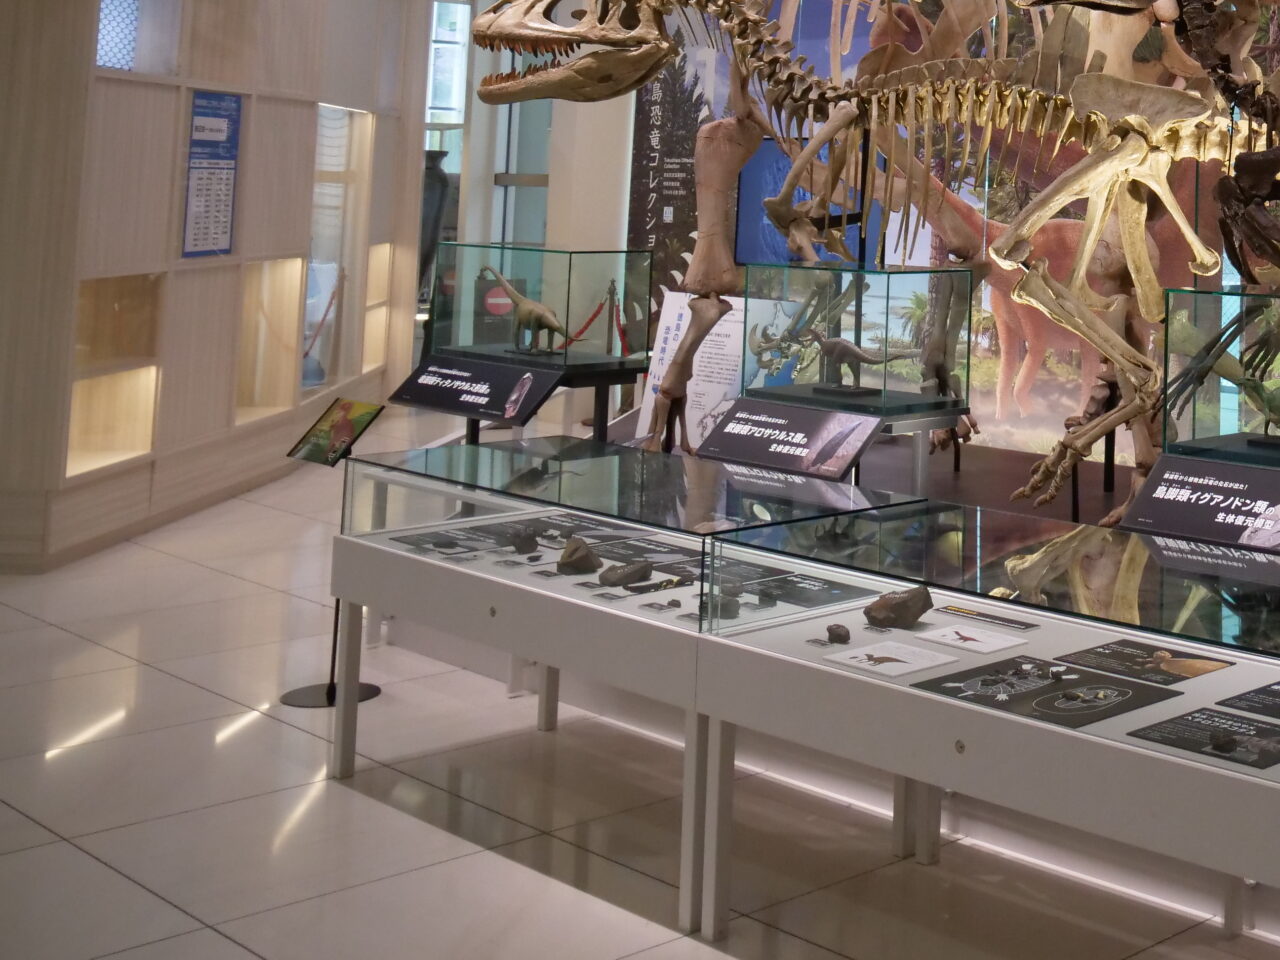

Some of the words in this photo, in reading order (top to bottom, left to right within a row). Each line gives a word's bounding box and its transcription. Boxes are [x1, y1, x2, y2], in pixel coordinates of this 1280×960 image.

[643, 70, 664, 266] 島恐竜コレクショ
[1152, 485, 1275, 515] 鳥脚類イグアノドン類の
[1214, 512, 1275, 530] 生体復元模型
